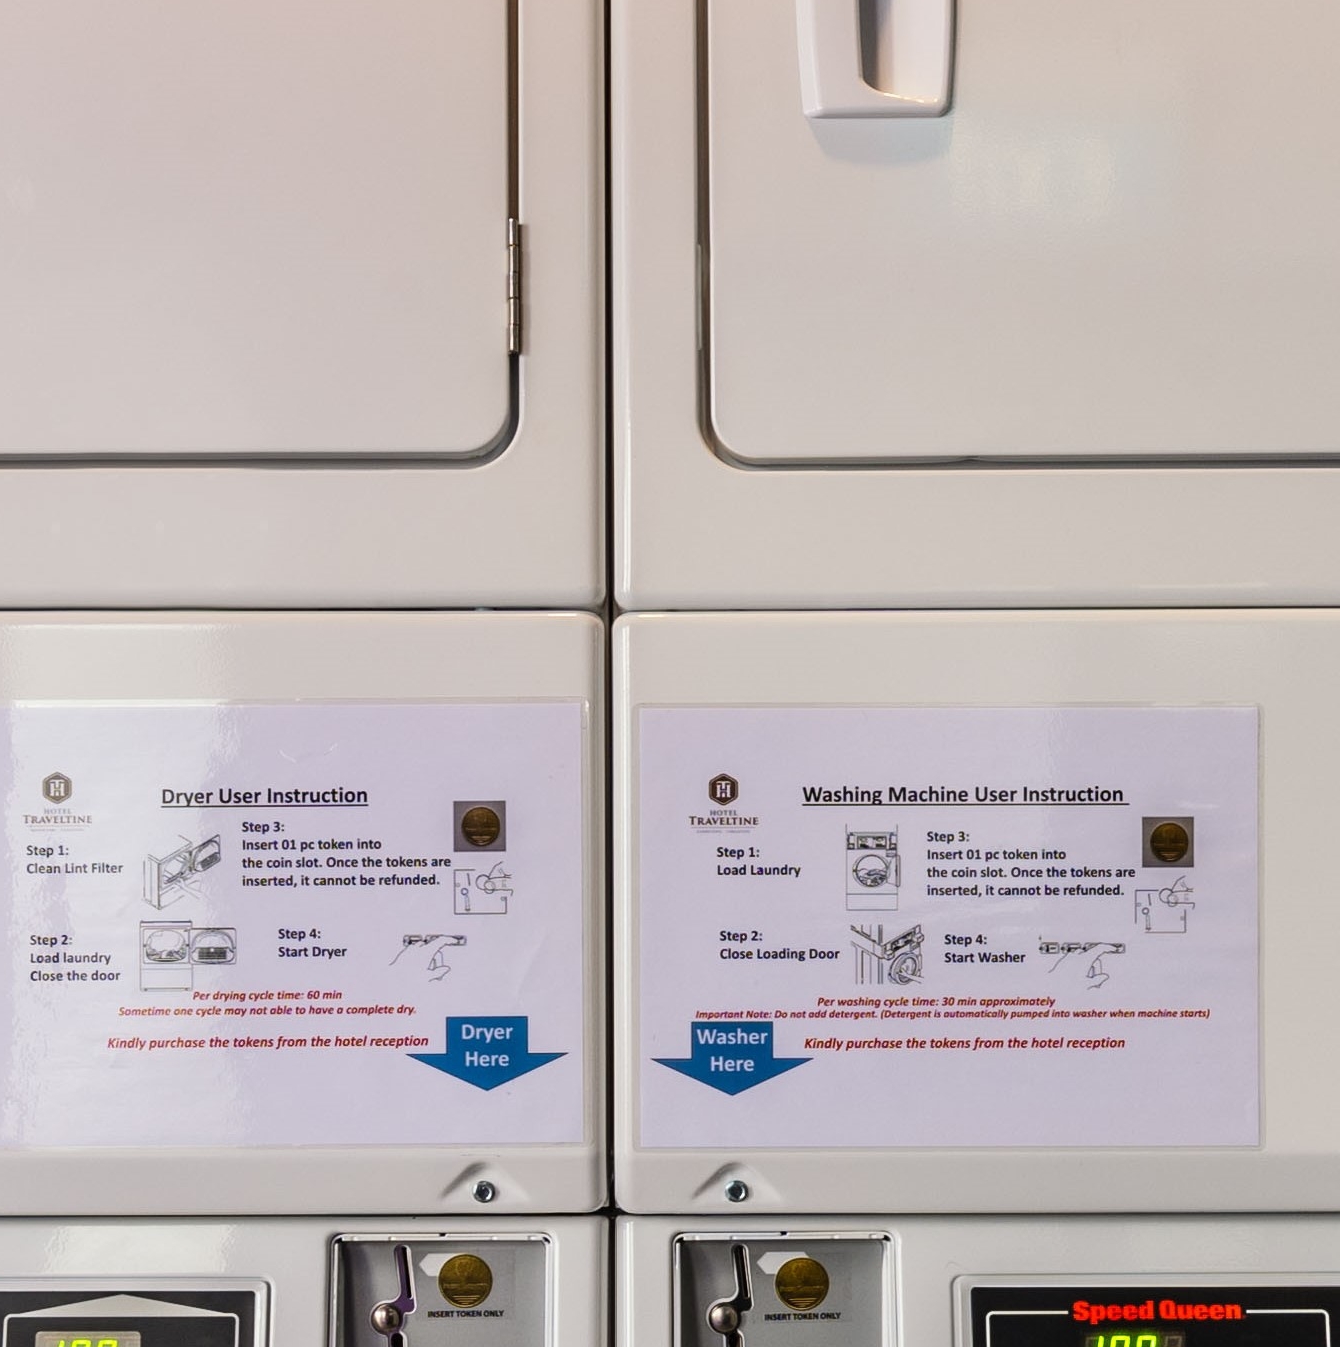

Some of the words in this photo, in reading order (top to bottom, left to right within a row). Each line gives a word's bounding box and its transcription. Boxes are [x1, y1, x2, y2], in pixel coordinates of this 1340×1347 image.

[162, 788, 213, 806] Dryer
[219, 788, 261, 804] User
[268, 787, 368, 804] Instruction
[802, 786, 882, 804] Washing
[889, 786, 968, 802] Machine
[976, 786, 1017, 802] User
[1024, 785, 1124, 802] Instruction
[23, 815, 92, 824] TRAVELTINE
[689, 816, 758, 825] TRAVELTINE
[927, 831, 954, 844] Step
[959, 831, 969, 842] 3:
[717, 847, 744, 859] Step
[749, 847, 759, 857] 1:
[928, 850, 963, 859] Insert
[967, 849, 981, 859] 01
[985, 852, 999, 862] pc
[1003, 849, 1037, 859] token
[1042, 849, 1066, 859] into
[718, 865, 746, 875] Load
[751, 865, 801, 877] Laundry
[945, 934, 972, 947] Step
[976, 934, 987, 944] 4:
[945, 952, 974, 963] Start
[978, 952, 1025, 962] Washer
[462, 1024, 513, 1043] Dryer
[697, 1028, 768, 1044] Washer
[805, 1038, 843, 1051] Kindly
[846, 1038, 902, 1051] purchase
[906, 1038, 926, 1048] the
[930, 1038, 971, 1048] tokens
[973, 1037, 1004, 1050] from
[1008, 1038, 1028, 1048] the
[1031, 1038, 1063, 1048] hotel
[1067, 1037, 1125, 1050] reception
[466, 1052, 509, 1066] Here
[711, 1056, 754, 1071] Here
[1072, 1301, 1154, 1323] Speed
[1160, 1301, 1242, 1320] Queen
